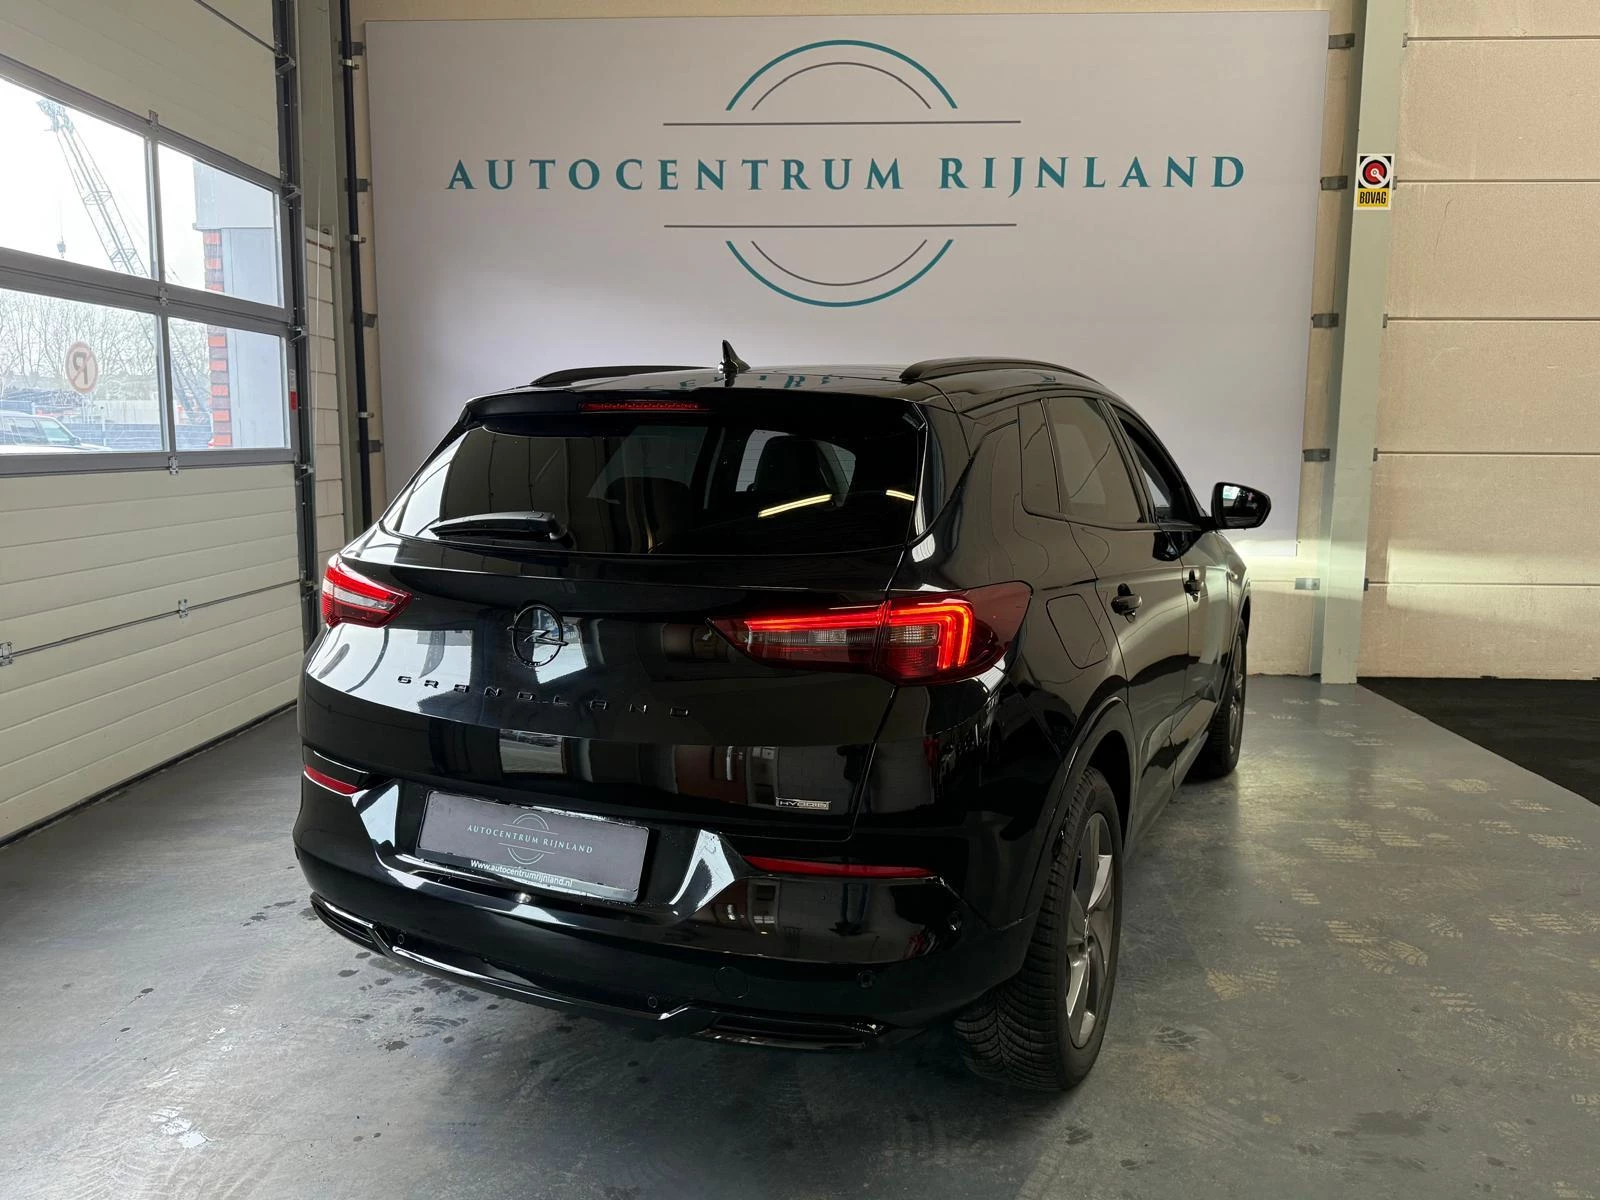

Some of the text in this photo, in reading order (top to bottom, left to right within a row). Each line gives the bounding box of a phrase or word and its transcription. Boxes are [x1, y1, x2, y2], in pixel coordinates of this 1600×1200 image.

[444, 155, 1244, 198] AUTOCENTRUM RIJNLAND
[1359, 191, 1387, 205] BOVAG
[397, 674, 690, 718] GRANDLAND
[466, 824, 593, 854] AUTOCENTRUM RIJNLAND
